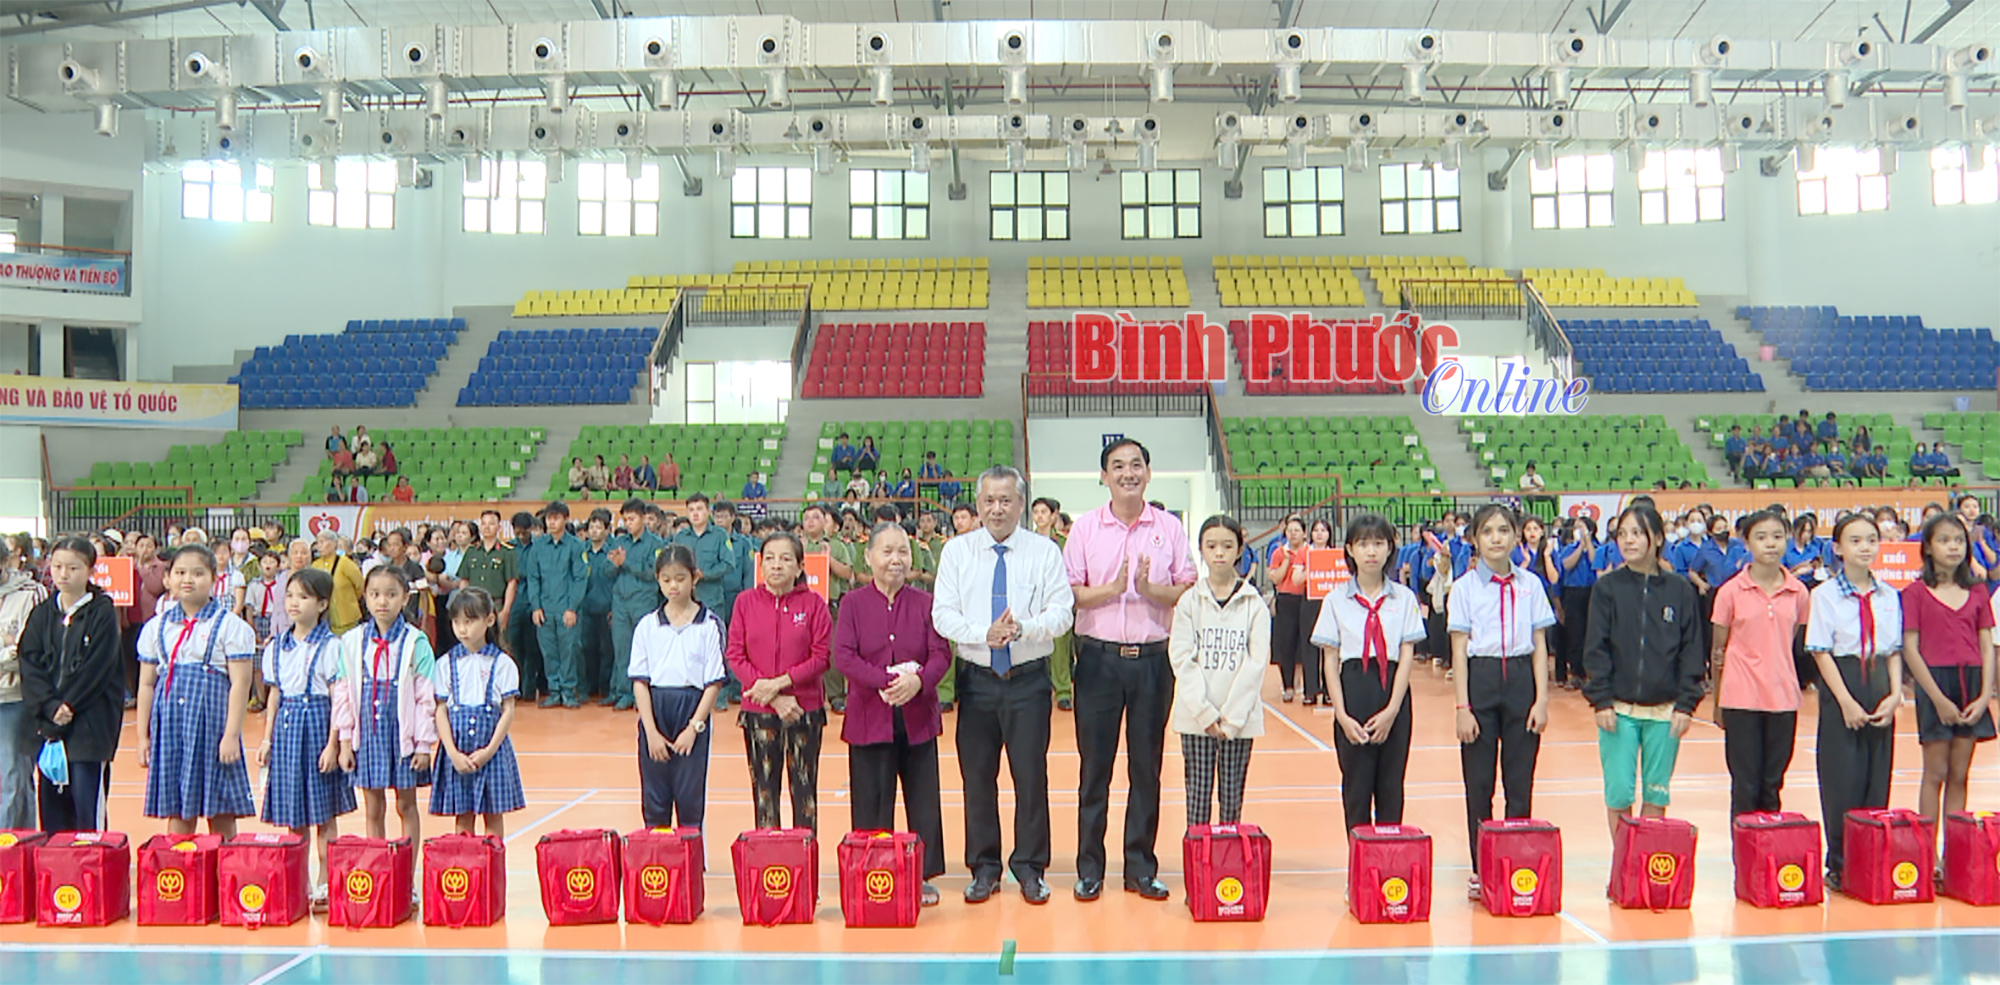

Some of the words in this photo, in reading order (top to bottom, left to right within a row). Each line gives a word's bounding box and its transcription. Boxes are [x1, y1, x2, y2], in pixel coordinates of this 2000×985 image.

[16, 263, 60, 284] THƯỢNG
[64, 265, 76, 282] VÀ
[80, 264, 101, 284] TIẾN
[103, 268, 118, 288] BỘ
[26, 386, 47, 408] VÀ
[53, 386, 83, 409] BẢO
[89, 389, 107, 414] VỆ
[137, 390, 178, 413] QUỐC
[1204, 651, 1237, 671] 1975
[1783, 872, 1799, 883] CP
[1897, 869, 1913, 881] CP
[1516, 876, 1533, 888] CP
[1221, 885, 1238, 897] CP
[1386, 885, 1403, 897] CP
[59, 893, 75, 904] CP
[244, 892, 260, 903] CP
